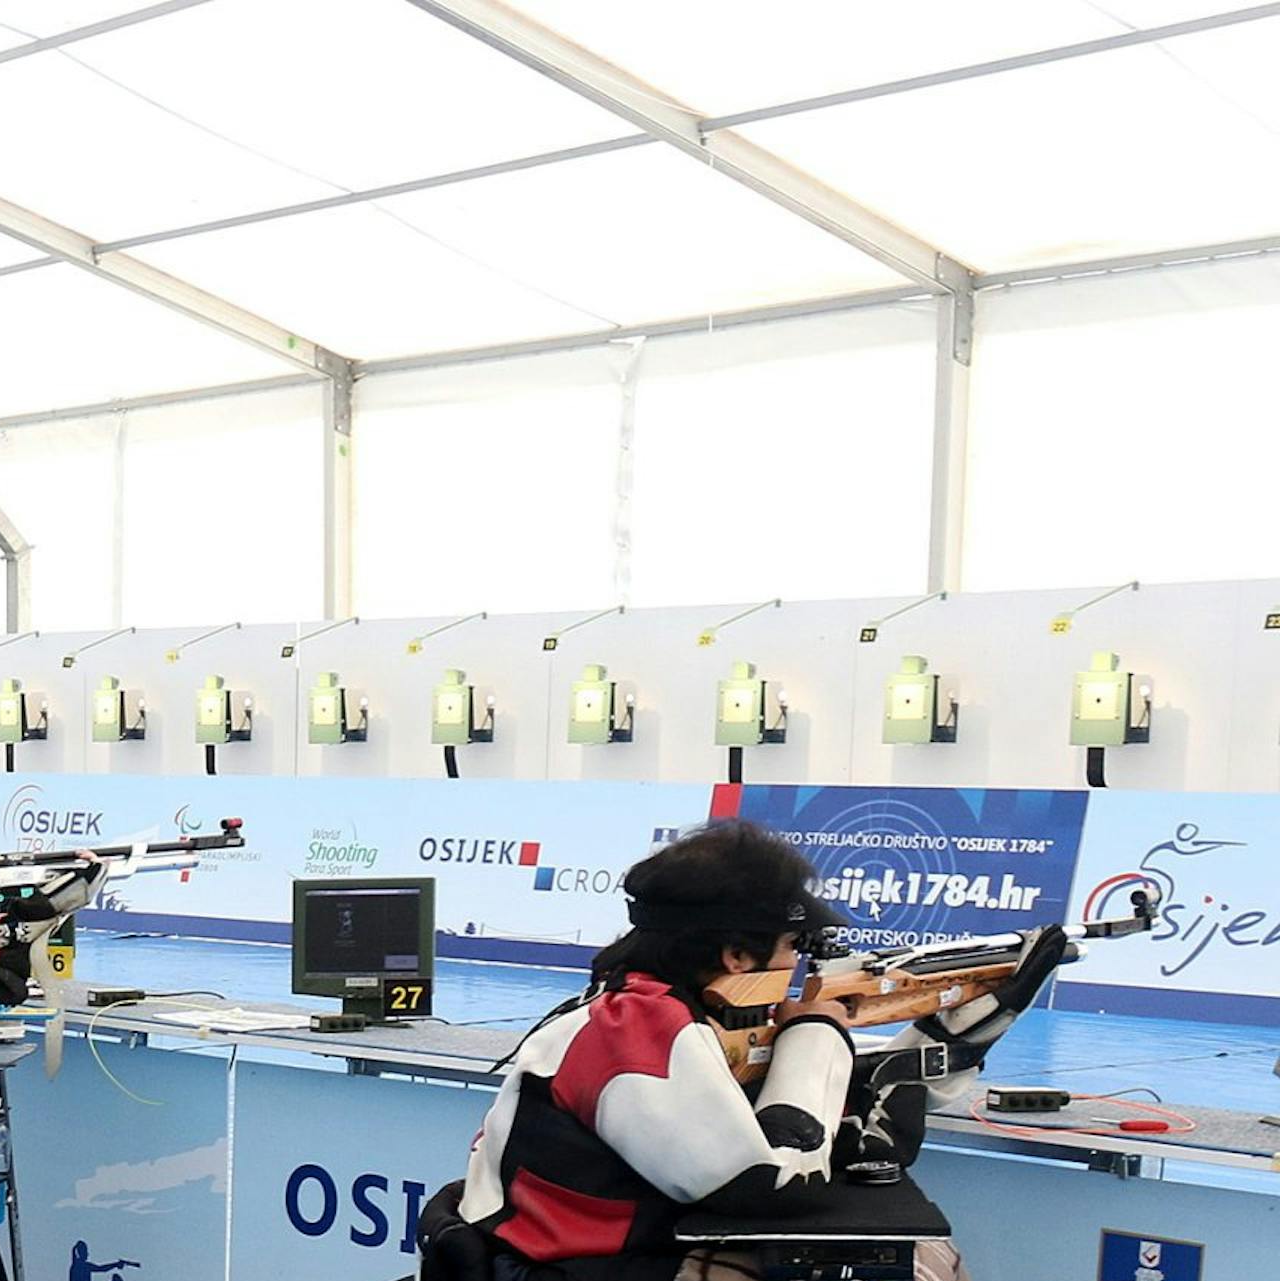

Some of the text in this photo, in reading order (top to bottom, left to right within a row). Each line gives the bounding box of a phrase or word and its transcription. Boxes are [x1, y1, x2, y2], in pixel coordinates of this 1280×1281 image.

[863, 631, 875, 640] 21
[1054, 624, 1067, 632] 22
[20, 810, 104, 836] OSIJEK
[312, 828, 341, 840] World
[419, 837, 517, 865] OSIJEK
[804, 831, 881, 847] STRELJAČKO
[883, 833, 947, 851] DRUŠTVO
[951, 836, 1007, 852] "OSIJEK
[1009, 838, 1055, 853] 1784"
[305, 841, 378, 869] Shooting
[304, 862, 353, 876] Para Sport
[804, 867, 1042, 912] osijek1784.hr
[49, 953, 65, 972] 6
[391, 986, 424, 1009] 27
[285, 1163, 425, 1254] OSI
